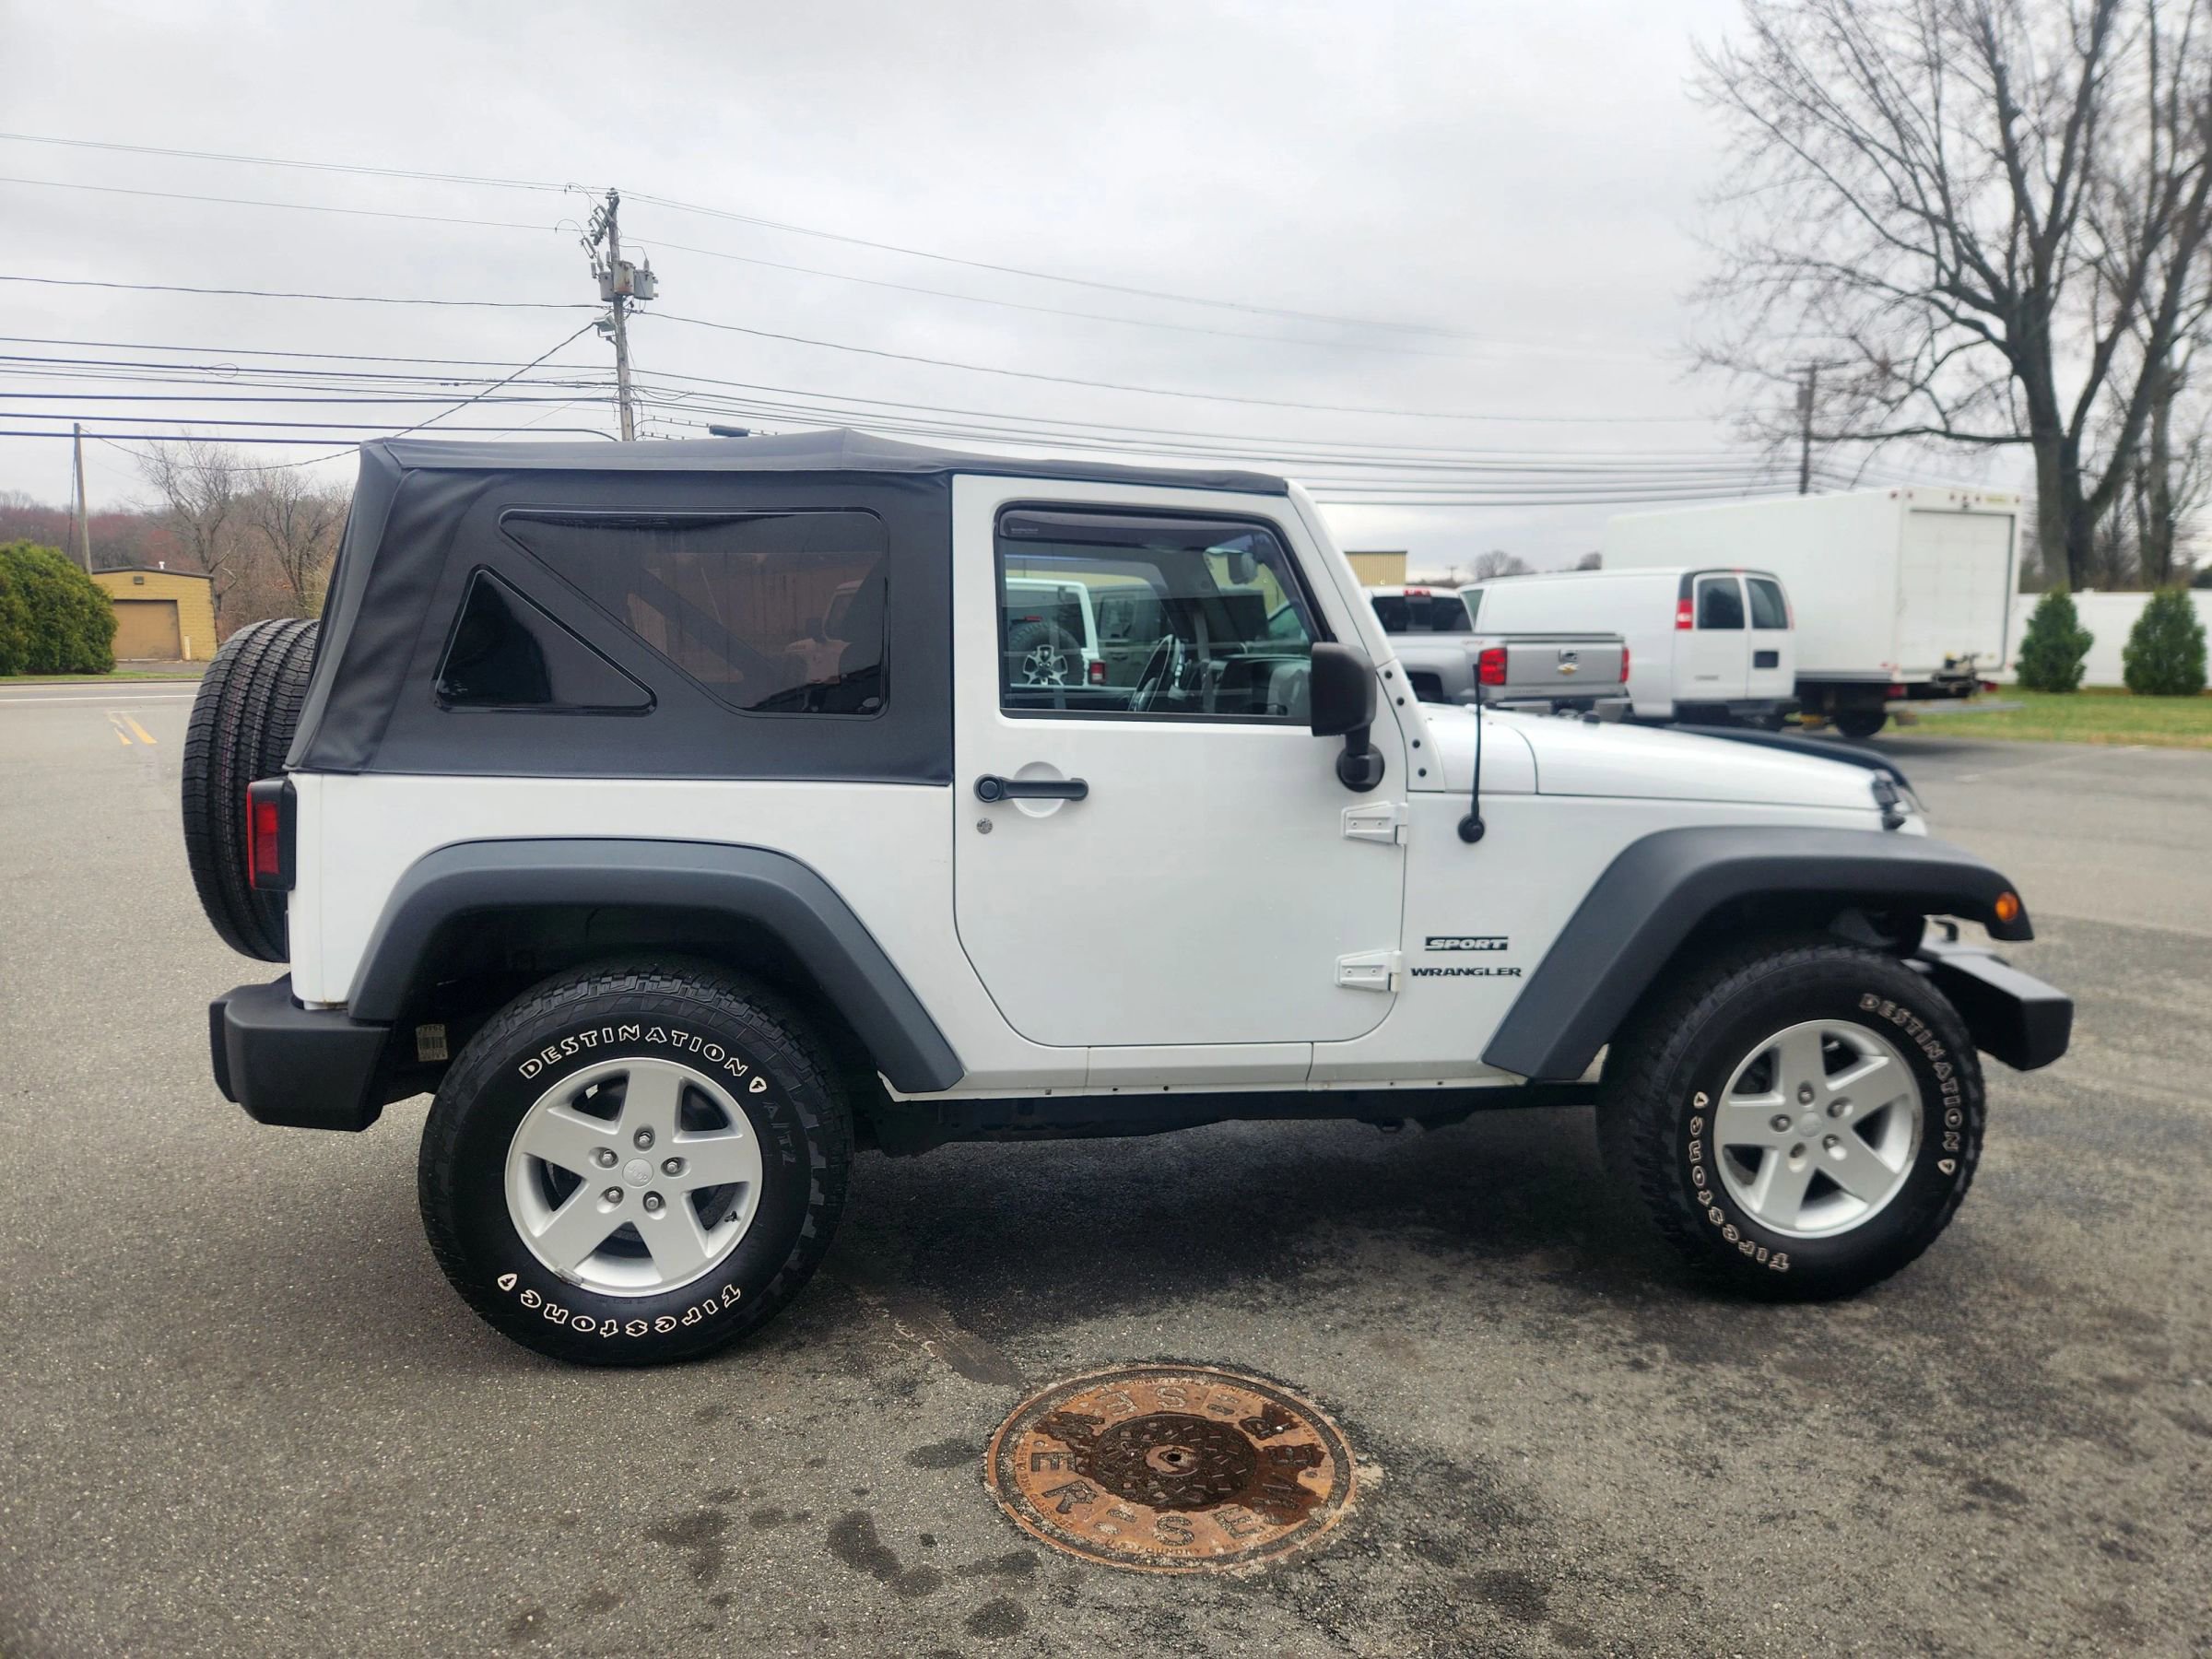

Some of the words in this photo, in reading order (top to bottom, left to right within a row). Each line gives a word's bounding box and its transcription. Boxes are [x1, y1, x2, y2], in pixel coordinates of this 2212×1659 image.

[1424, 937, 1509, 951] SPORT
[1410, 968, 1522, 977] WRANGLER
[518, 1024, 748, 1080] DESTINATION
[1858, 993, 1962, 1153] DESTINATION
